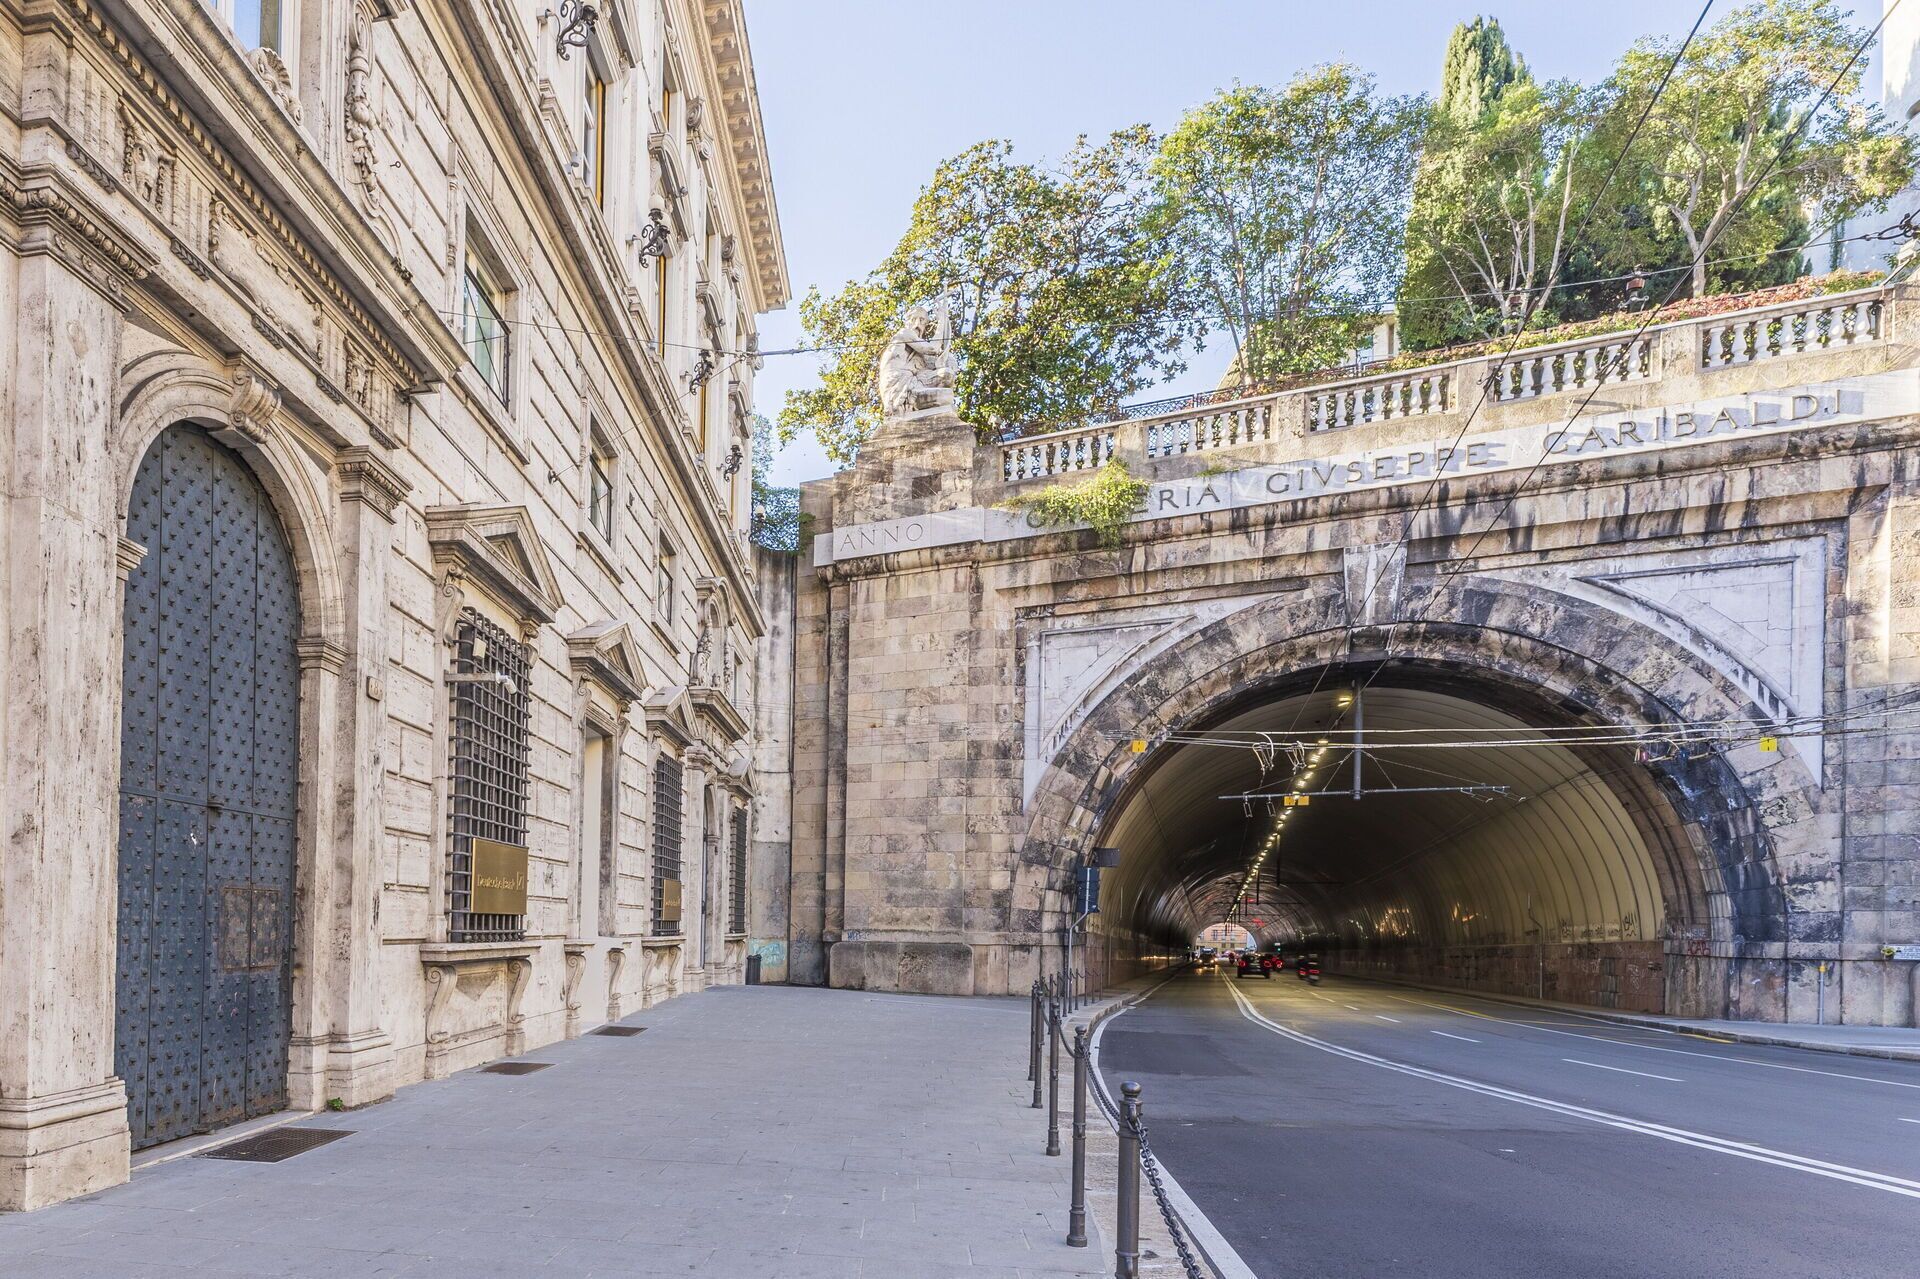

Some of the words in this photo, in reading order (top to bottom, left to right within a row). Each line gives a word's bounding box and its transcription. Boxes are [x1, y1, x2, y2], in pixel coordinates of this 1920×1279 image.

[1265, 442, 1488, 494] GIVSEPPE
[1542, 389, 1841, 454] GARIBALDI
[840, 523, 924, 552] ANNO
